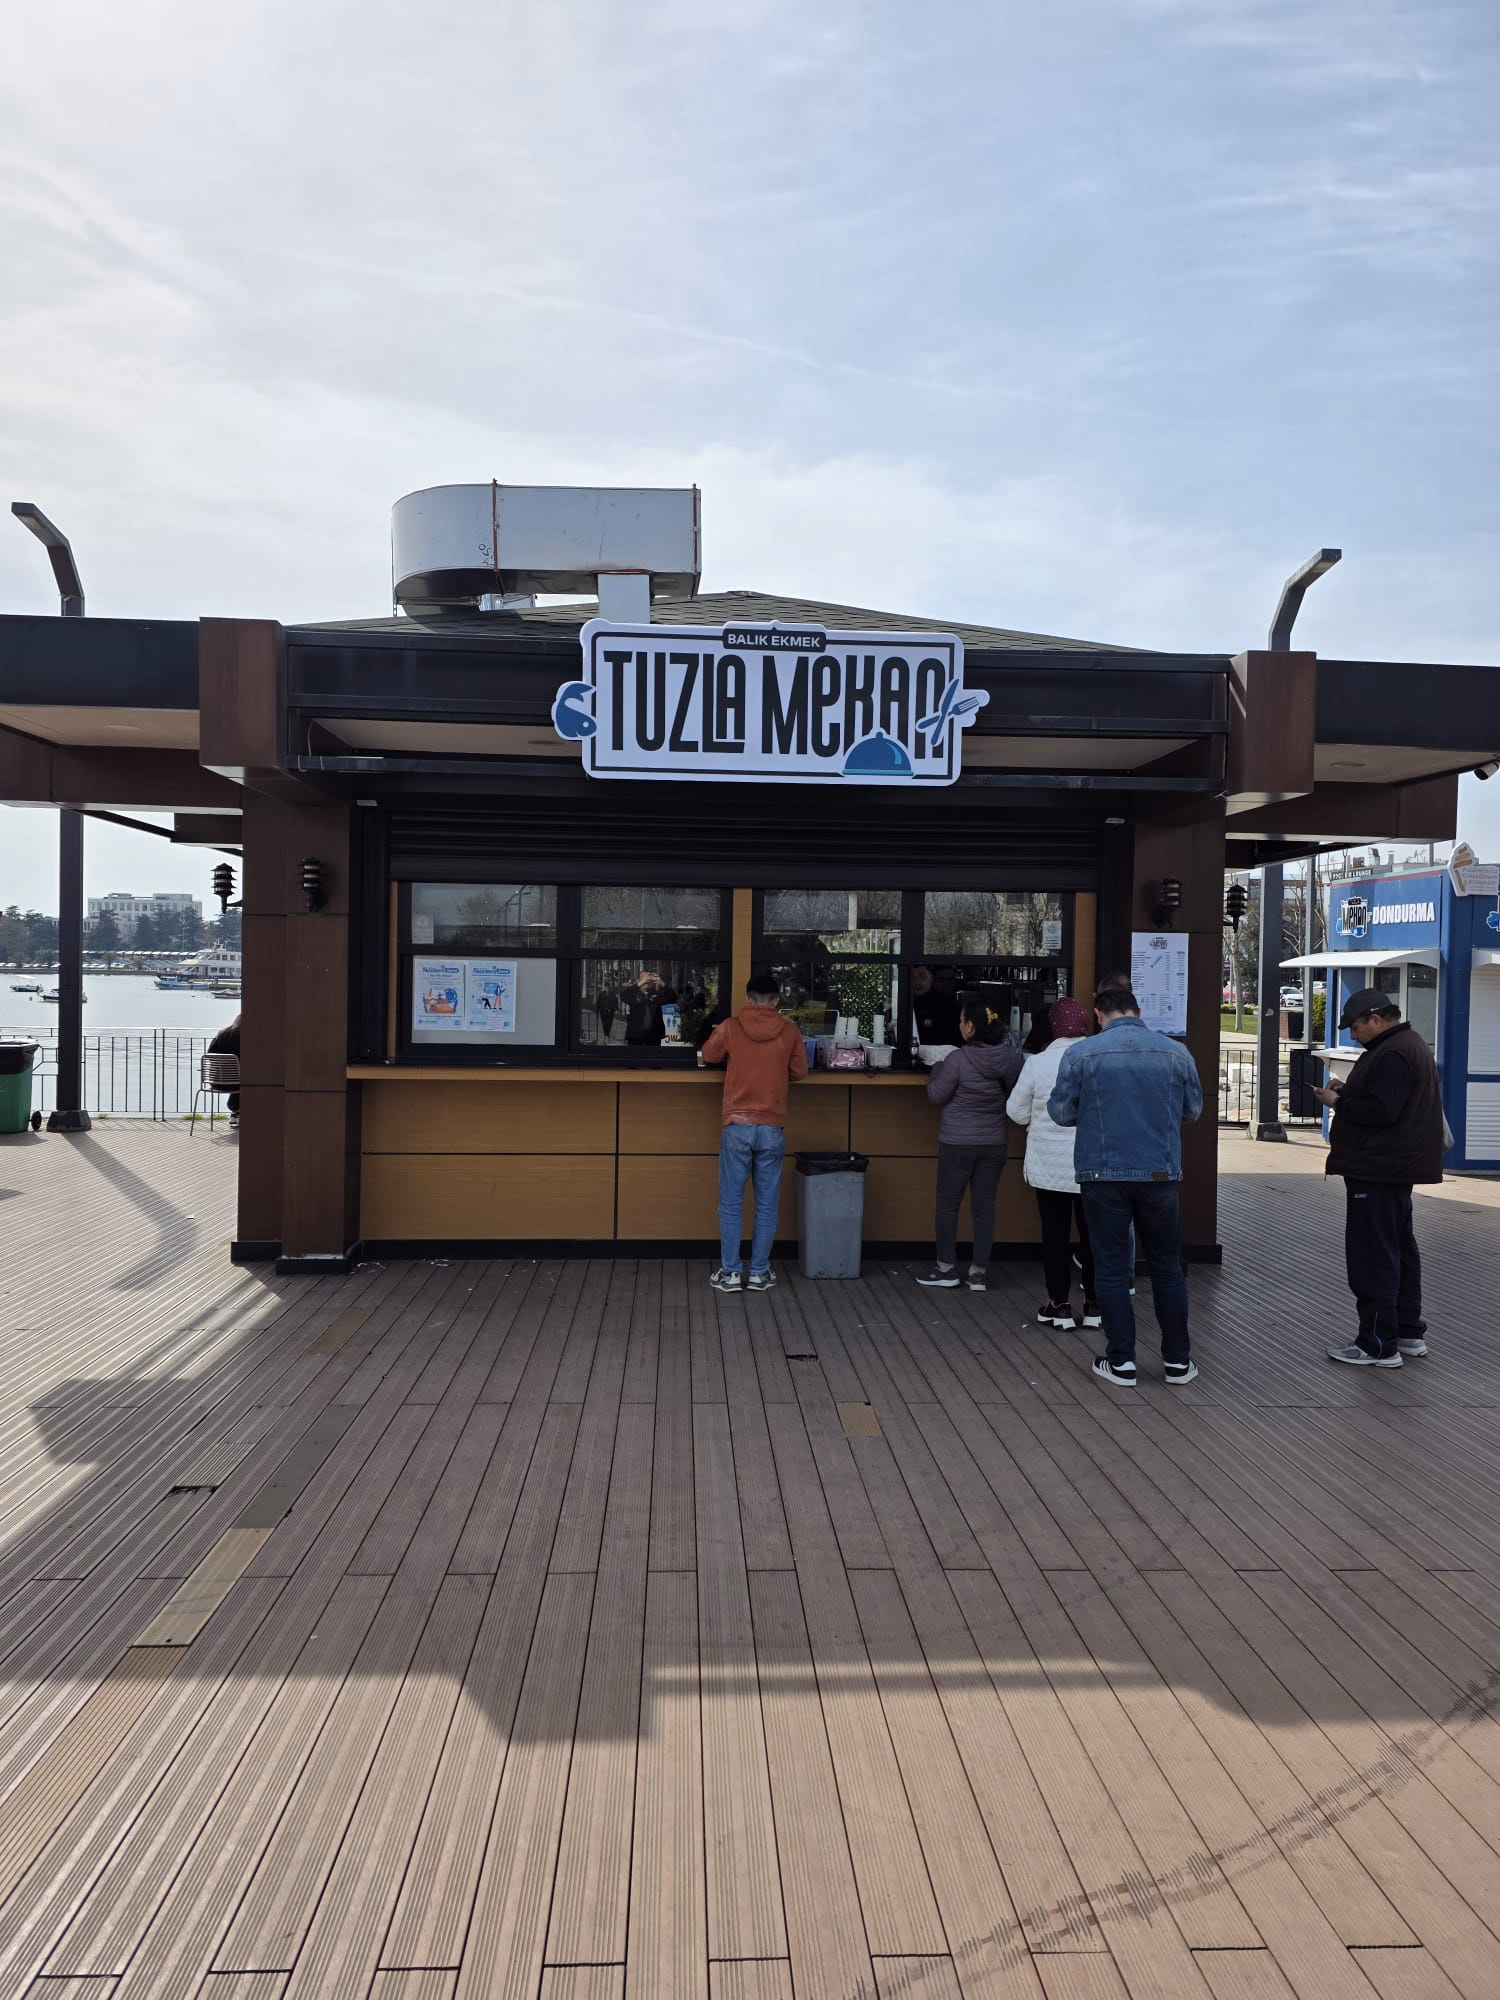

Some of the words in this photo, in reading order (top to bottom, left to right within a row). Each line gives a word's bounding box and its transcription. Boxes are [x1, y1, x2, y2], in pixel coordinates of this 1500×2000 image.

[727, 633, 768, 646] BALIK
[771, 635, 820, 648] EKMEK
[603, 650, 747, 754] TUZLA
[1372, 901, 1435, 925] DONDURMA
